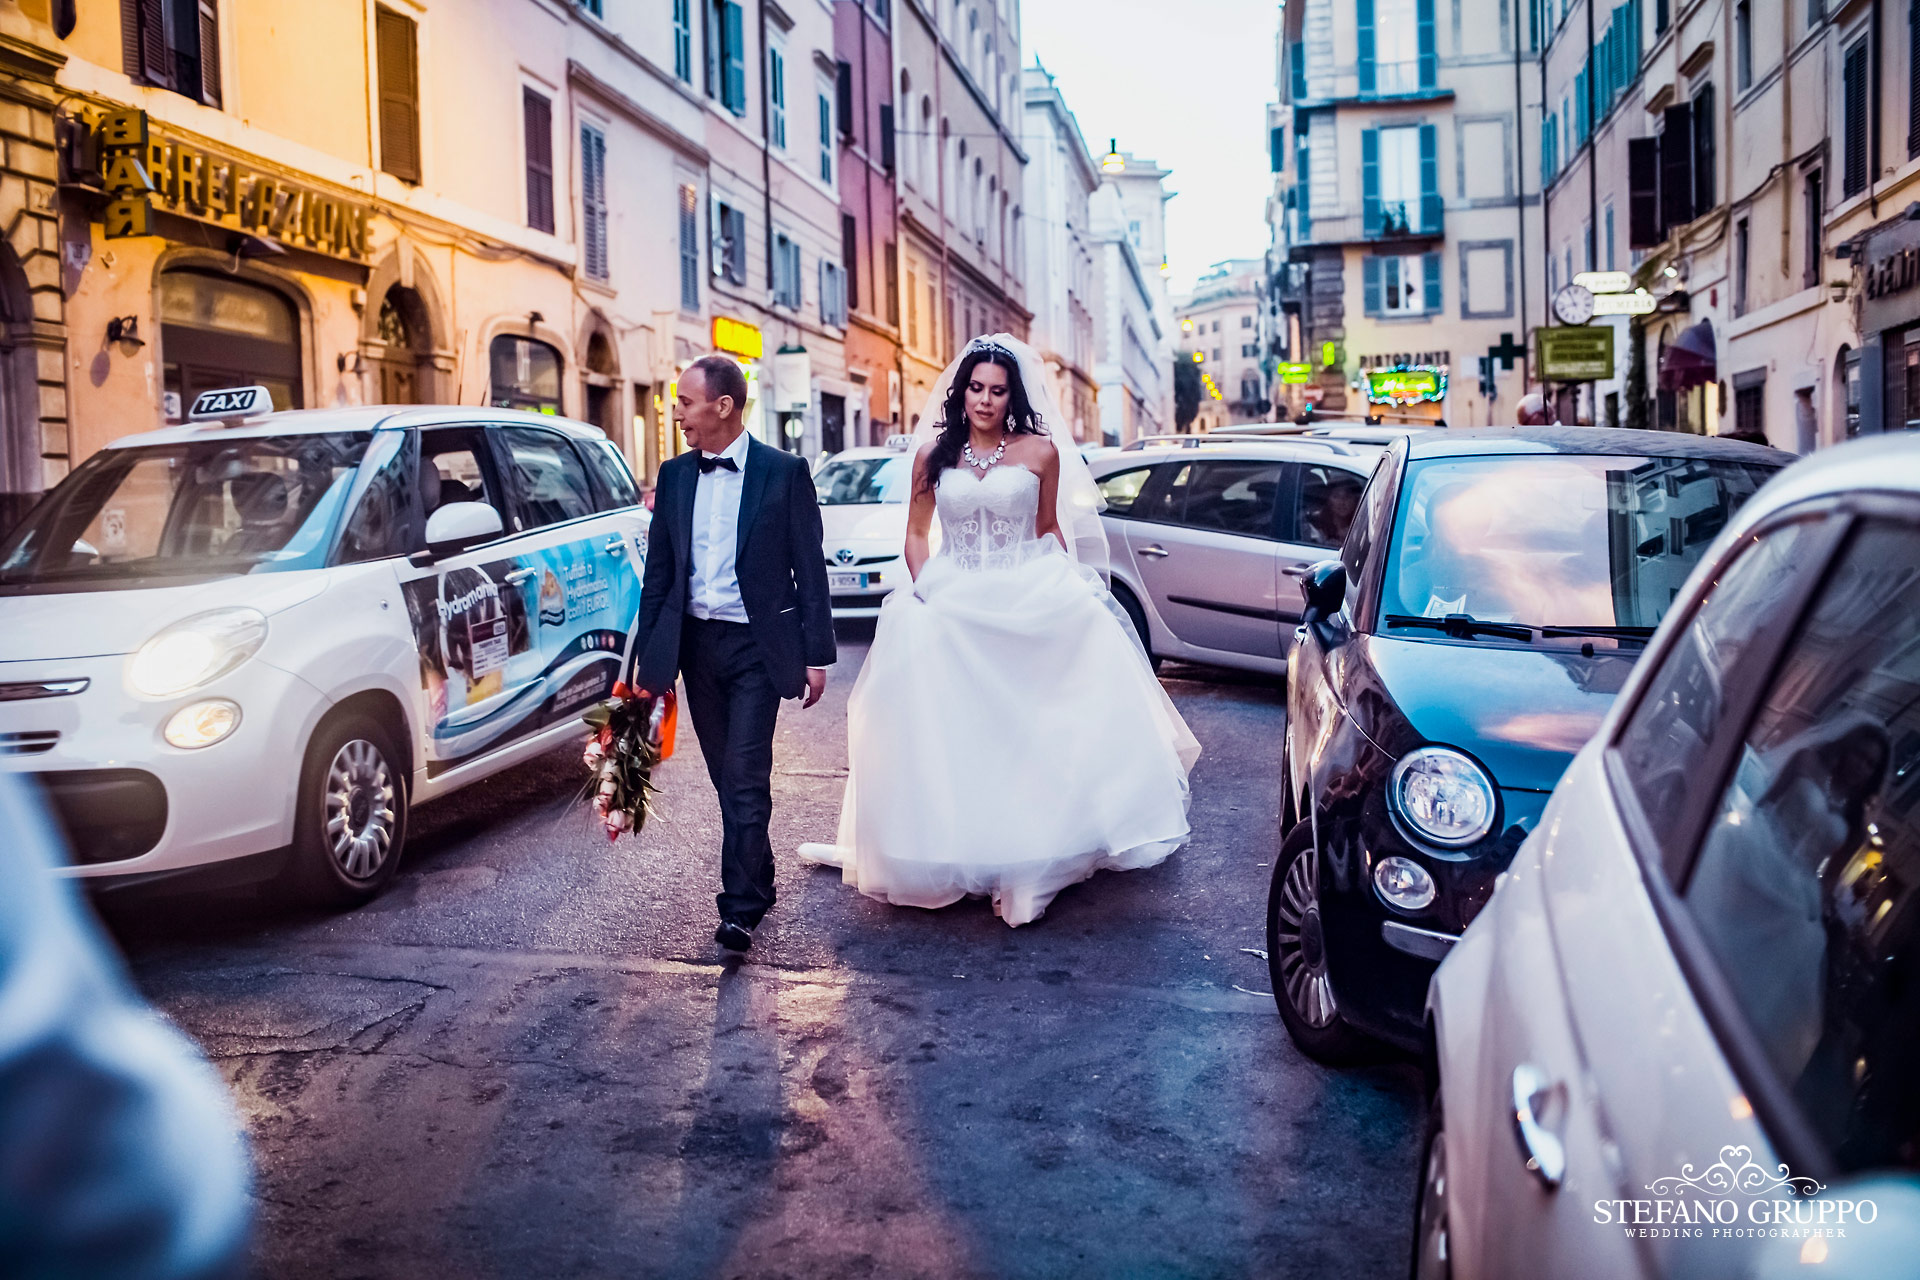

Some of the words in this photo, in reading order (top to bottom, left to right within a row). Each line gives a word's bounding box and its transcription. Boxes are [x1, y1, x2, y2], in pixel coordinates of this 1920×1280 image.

[103, 109, 153, 239] BAR
[145, 131, 375, 256] RREFAZIONE
[200, 392, 254, 412] TAXI
[435, 583, 498, 620] Hydromania
